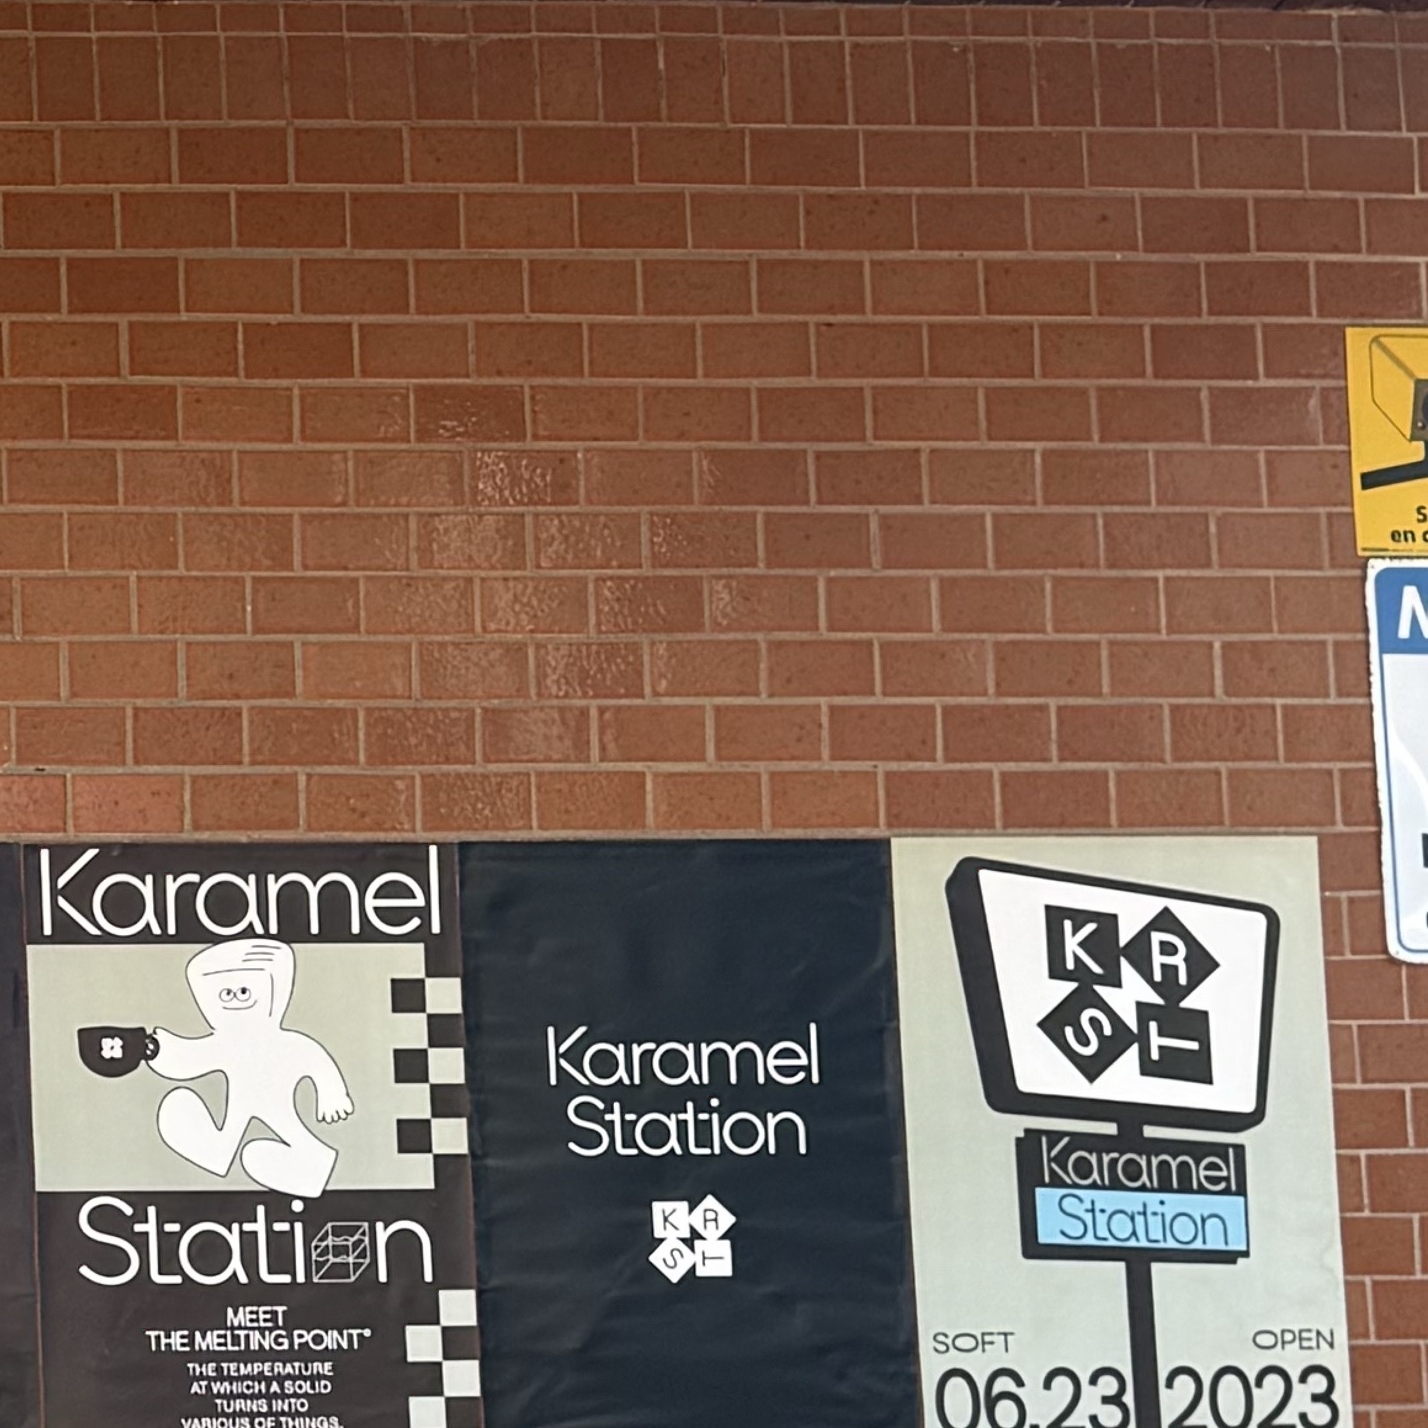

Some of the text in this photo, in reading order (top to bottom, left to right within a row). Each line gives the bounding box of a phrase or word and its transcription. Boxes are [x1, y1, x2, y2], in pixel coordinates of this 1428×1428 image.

[40, 844, 441, 937] Karamel
[547, 1022, 820, 1086] Karamel
[566, 1095, 807, 1157] Station
[1041, 1136, 1237, 1192] Karamel
[1057, 1194, 1229, 1246] Station
[78, 1191, 433, 1286] Statin
[226, 1305, 288, 1328] MEET
[145, 1330, 191, 1352] THE
[194, 1329, 290, 1351] MELTING
[932, 1331, 1015, 1355] SOFT
[1251, 1328, 1335, 1351] OPEN
[186, 1361, 334, 1377] THE TEMPERATURE
[190, 1379, 332, 1395] AT WHICH A SOLID
[214, 1397, 309, 1413] TURNS INTO
